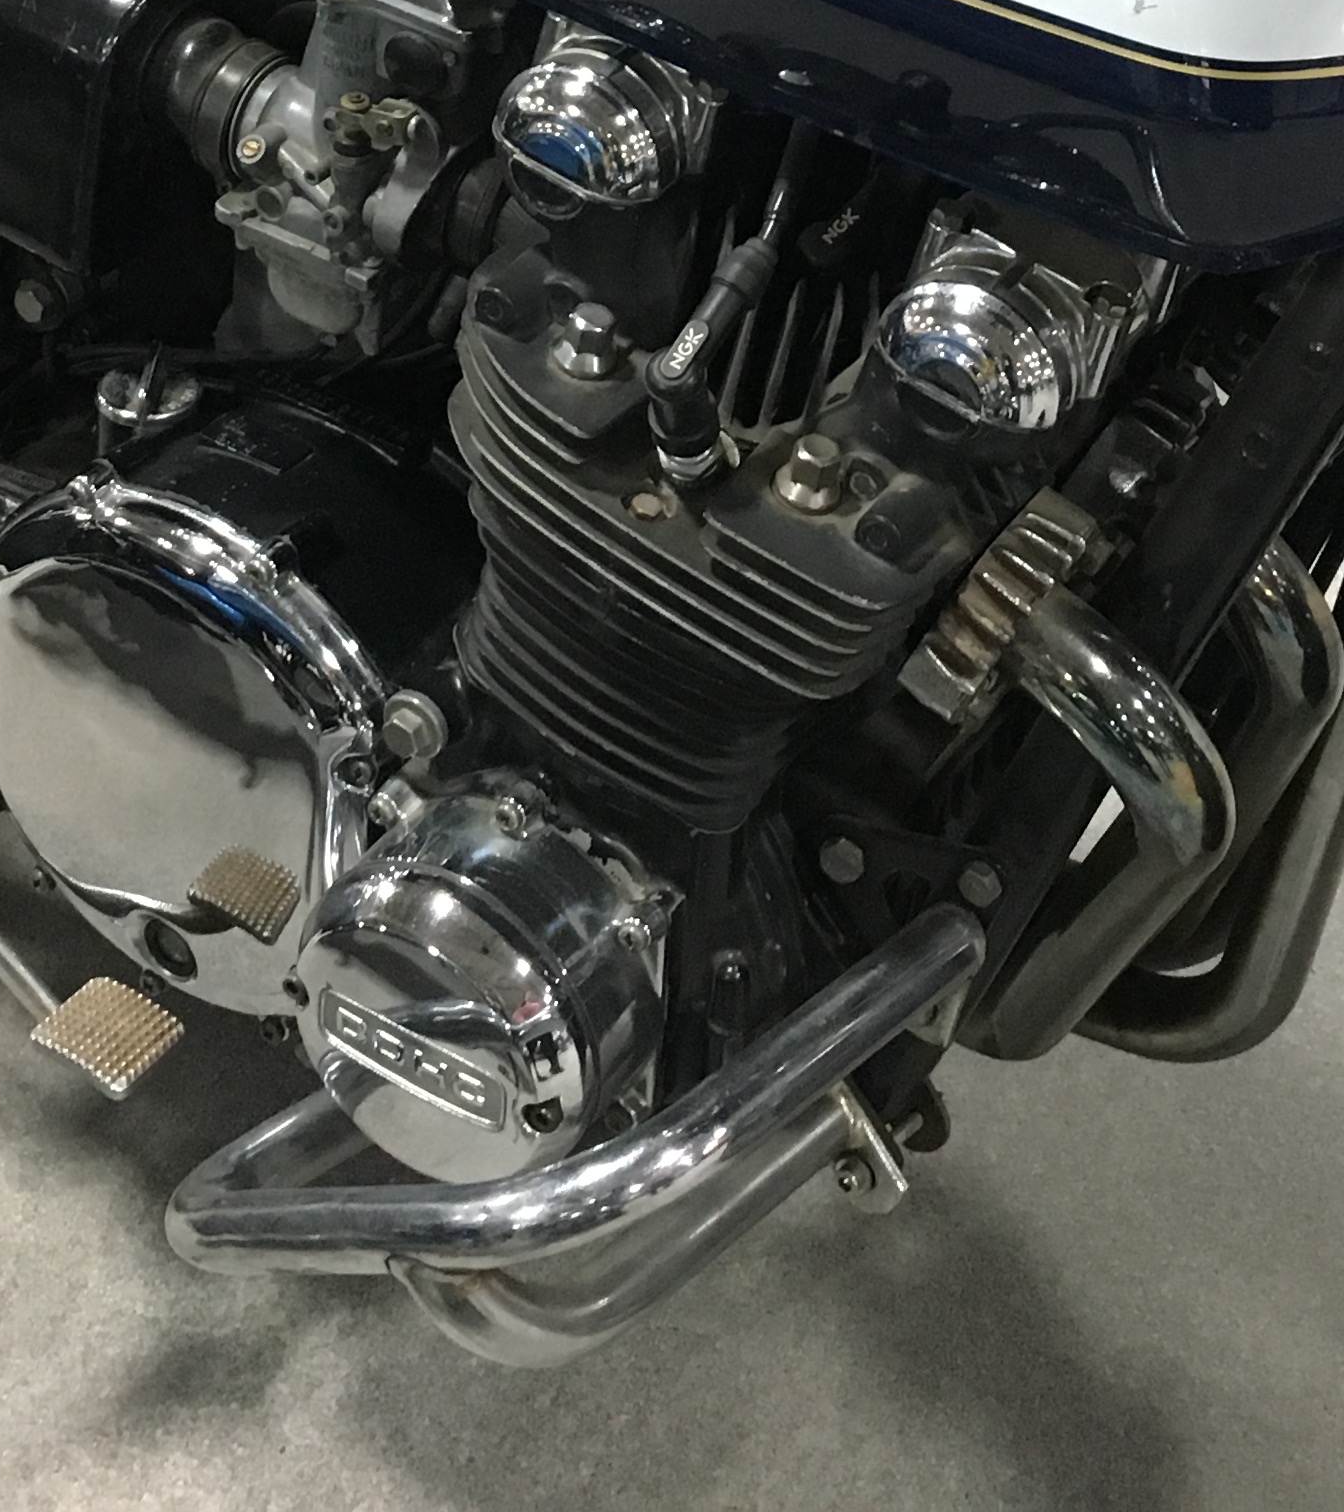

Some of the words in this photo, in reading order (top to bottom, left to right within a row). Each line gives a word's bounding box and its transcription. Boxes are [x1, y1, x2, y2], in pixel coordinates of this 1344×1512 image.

[821, 207, 860, 245] NGK
[669, 327, 704, 370] NGK
[336, 1005, 486, 1108] DOHC
